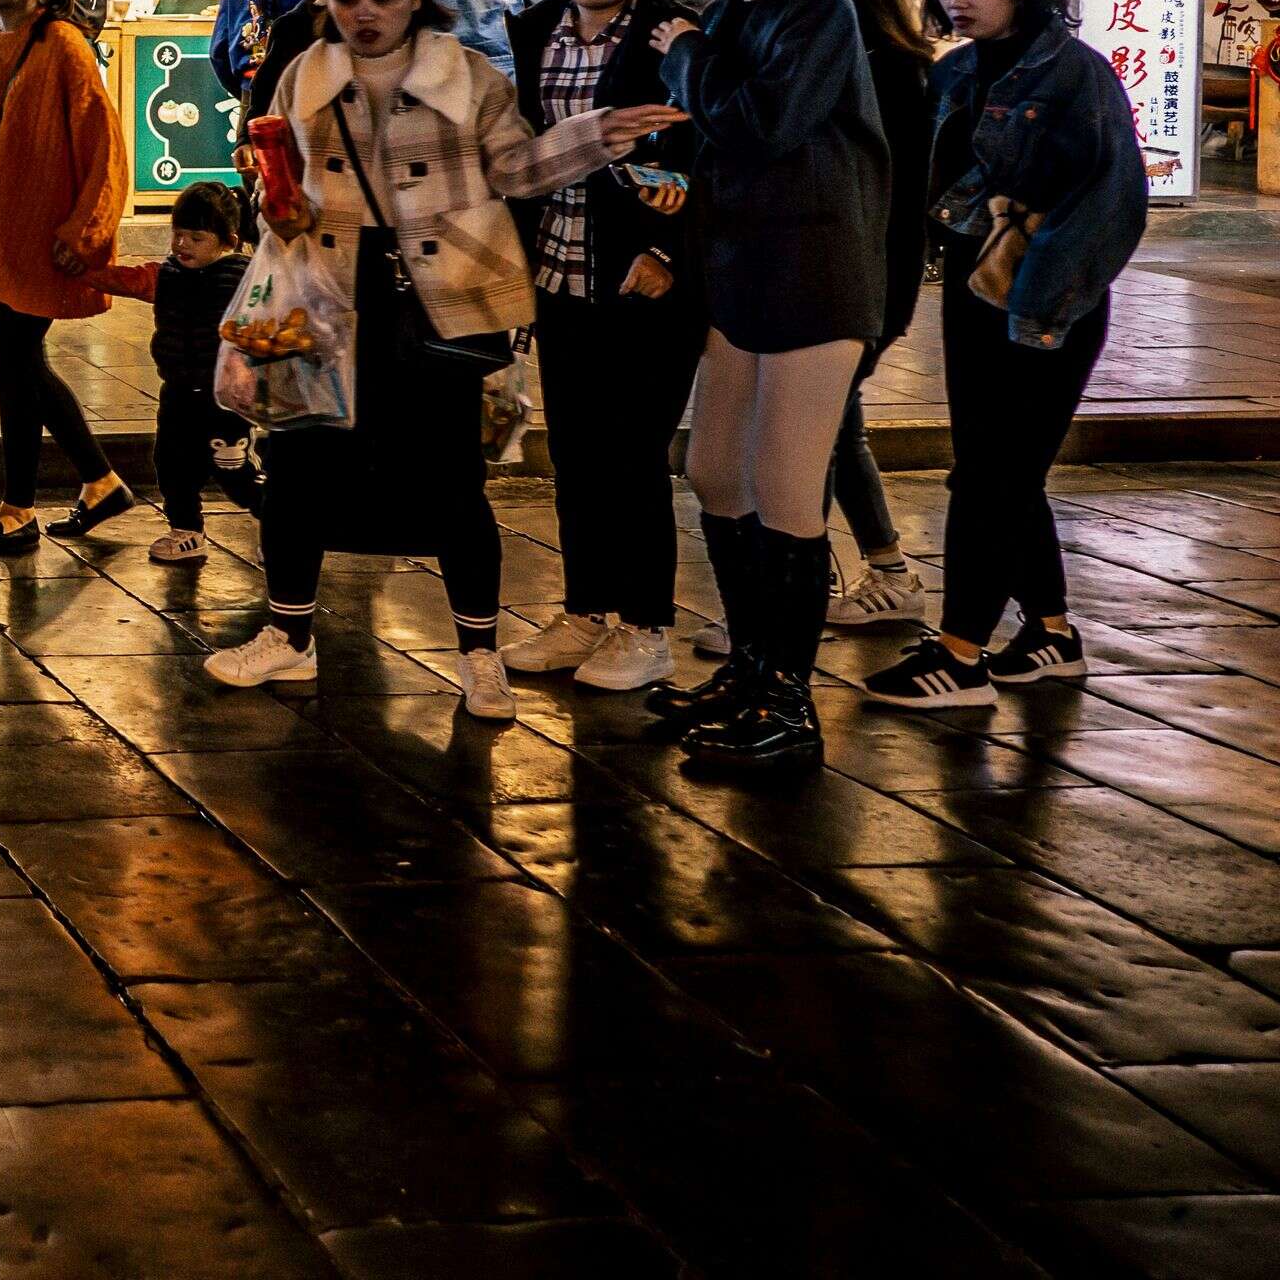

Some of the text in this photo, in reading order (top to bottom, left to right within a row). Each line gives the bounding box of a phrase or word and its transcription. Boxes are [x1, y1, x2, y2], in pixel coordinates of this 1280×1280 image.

[1163, 70, 1179, 137] 鼓楼演艺社
